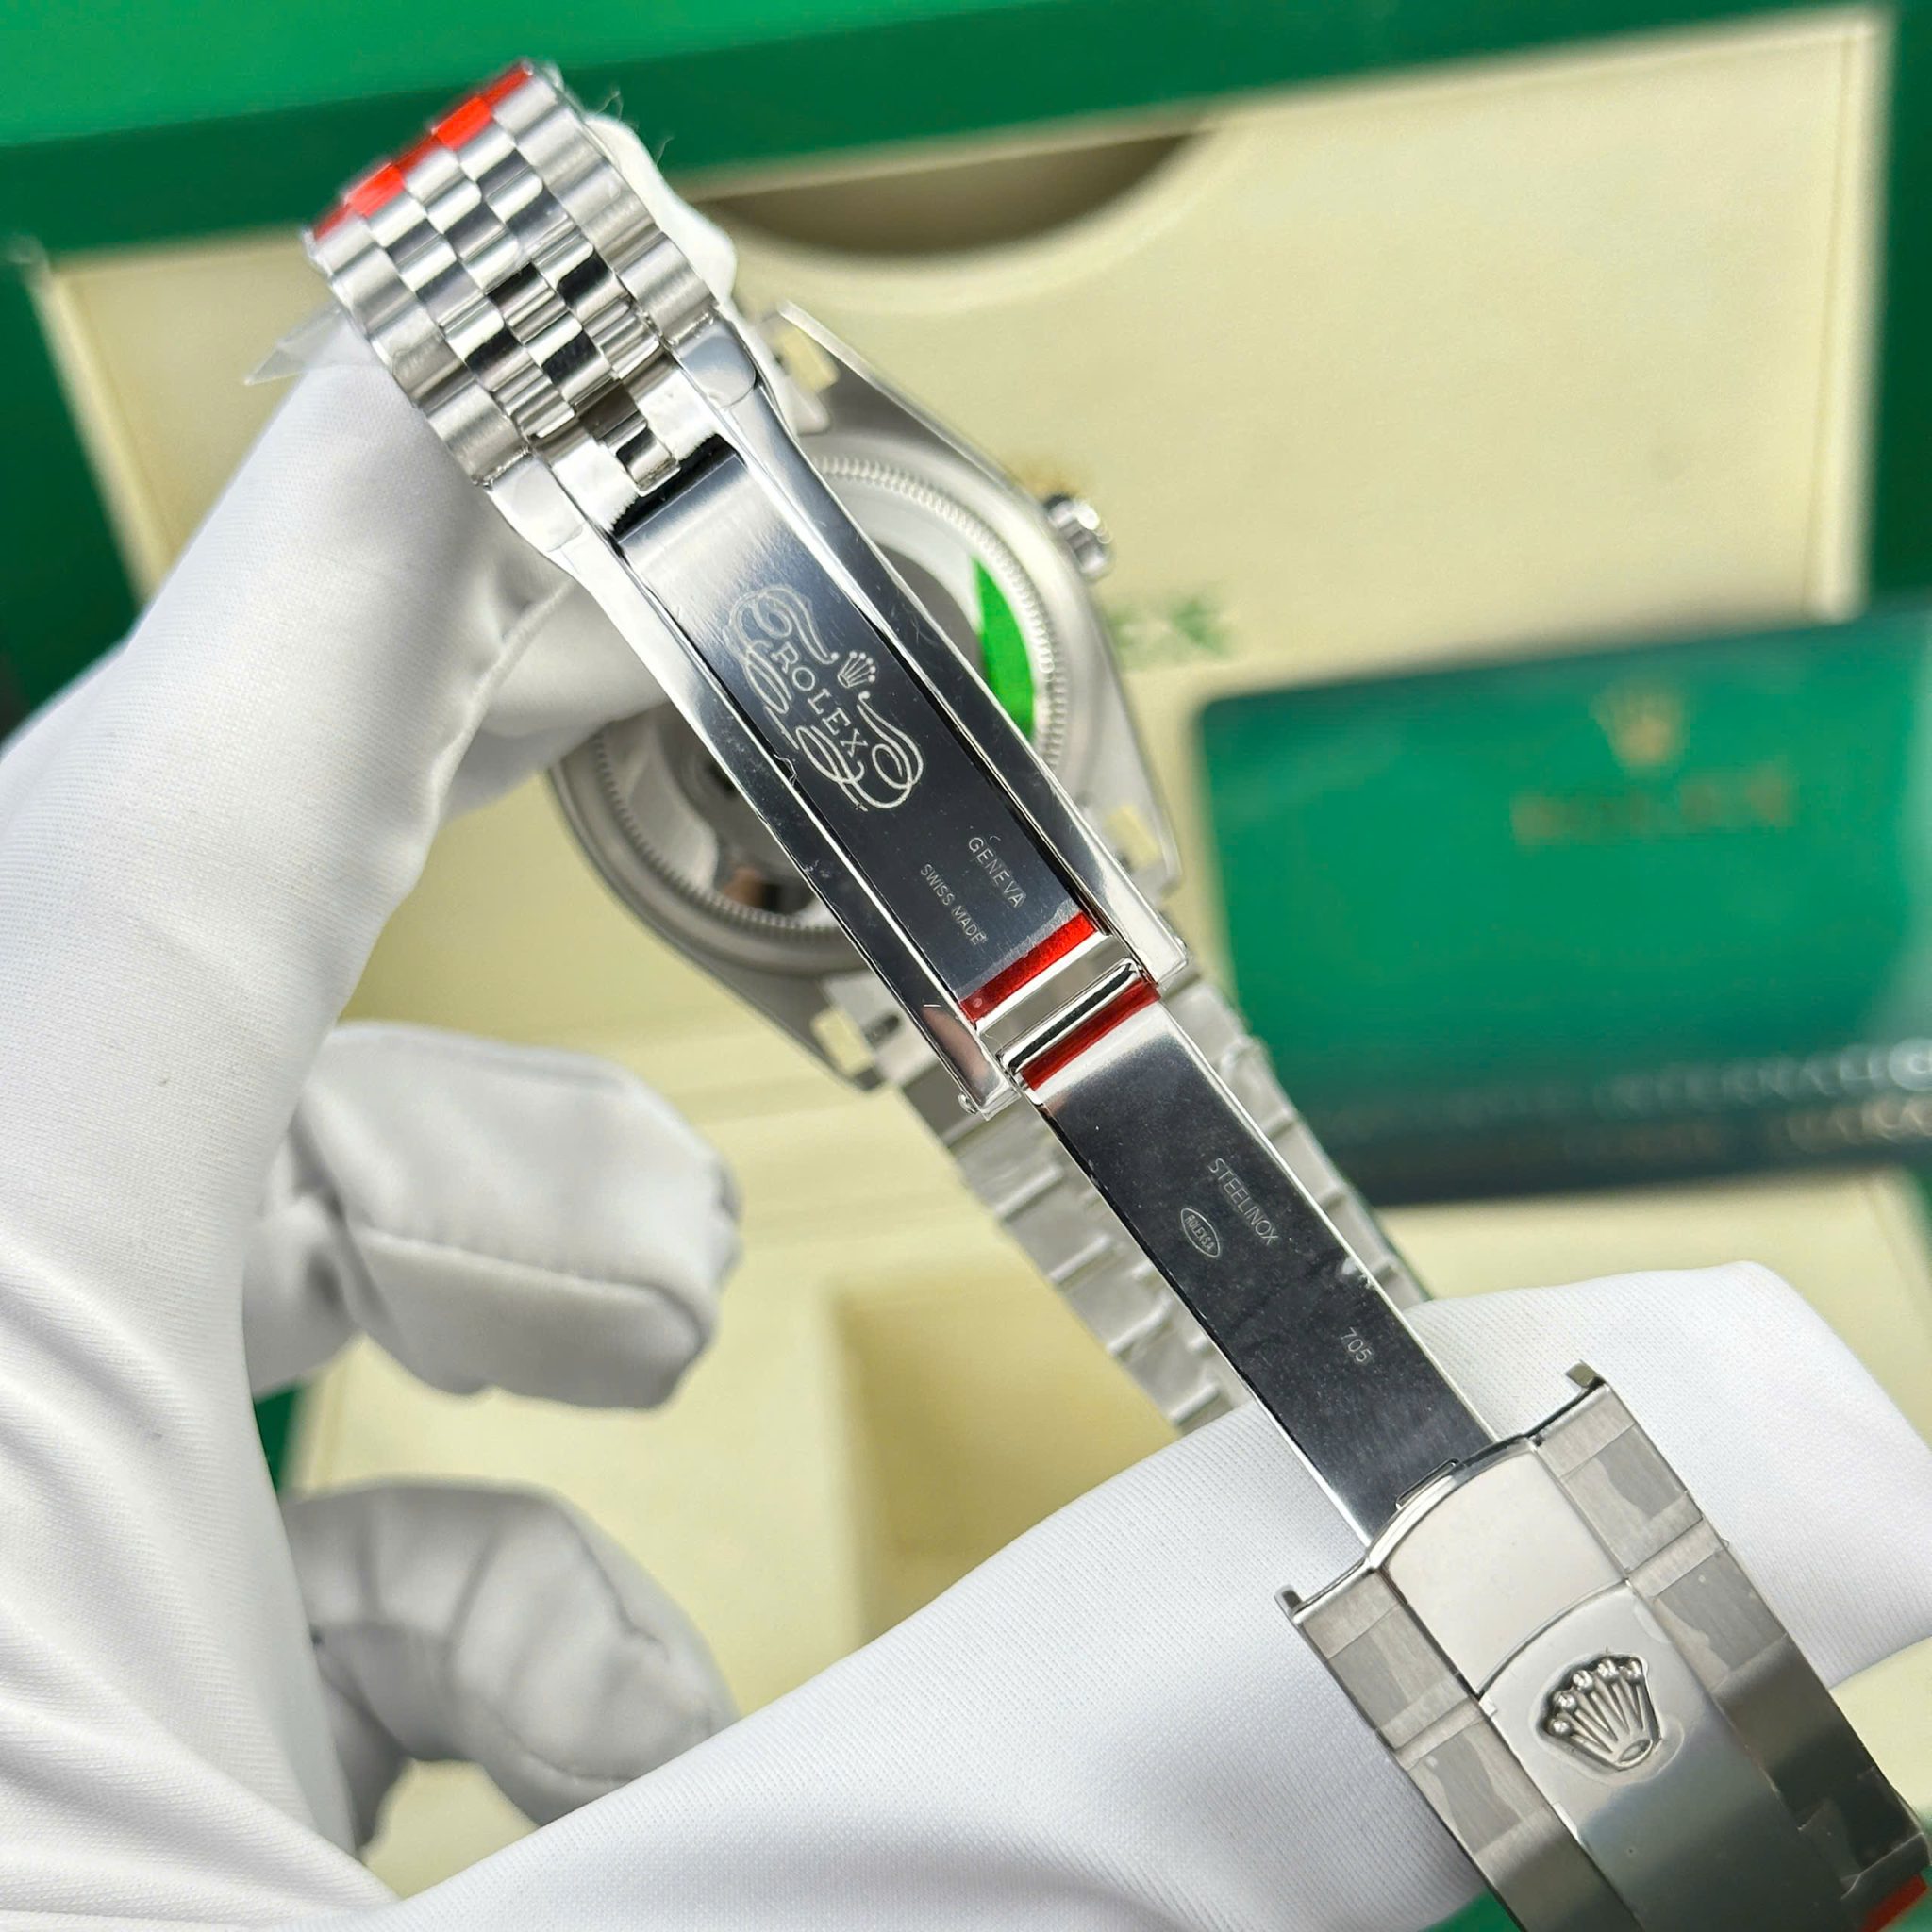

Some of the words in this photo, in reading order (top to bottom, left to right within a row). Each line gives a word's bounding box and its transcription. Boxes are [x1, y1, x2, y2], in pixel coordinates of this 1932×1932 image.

[770, 641, 868, 758] ROLEX
[920, 863, 955, 906] SWISS
[951, 905, 987, 945] MADE
[968, 837, 1026, 908] GENEVA
[1208, 1158, 1278, 1245] STEELINOX
[1341, 1326, 1373, 1363] 705
